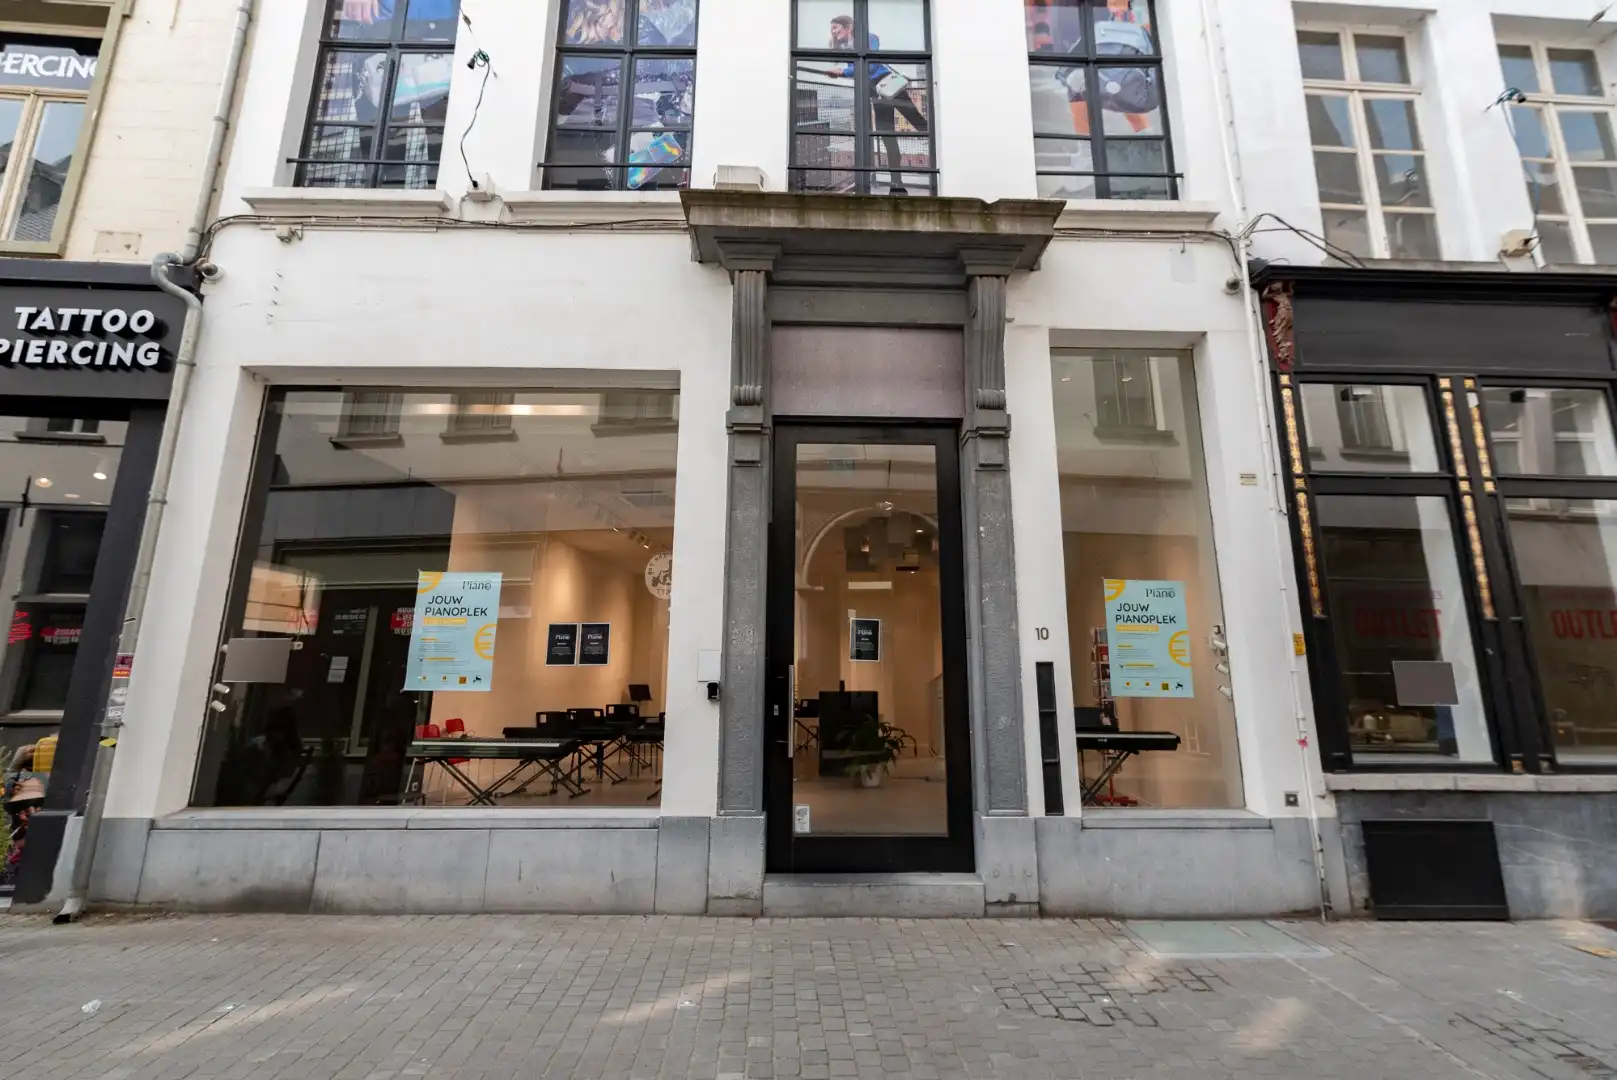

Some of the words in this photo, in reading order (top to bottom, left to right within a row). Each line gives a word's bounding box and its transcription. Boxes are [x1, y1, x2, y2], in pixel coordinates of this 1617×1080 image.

[15, 306, 155, 333] TATTOO
[462, 580, 492, 590] Piano
[1146, 588, 1176, 599] Piano
[428, 595, 463, 605] JOUW
[424, 607, 488, 617] PIANOPLEK
[1116, 603, 1150, 612] JOUW
[1115, 614, 1177, 624] PIANOPLEK
[1035, 627, 1049, 641] 10
